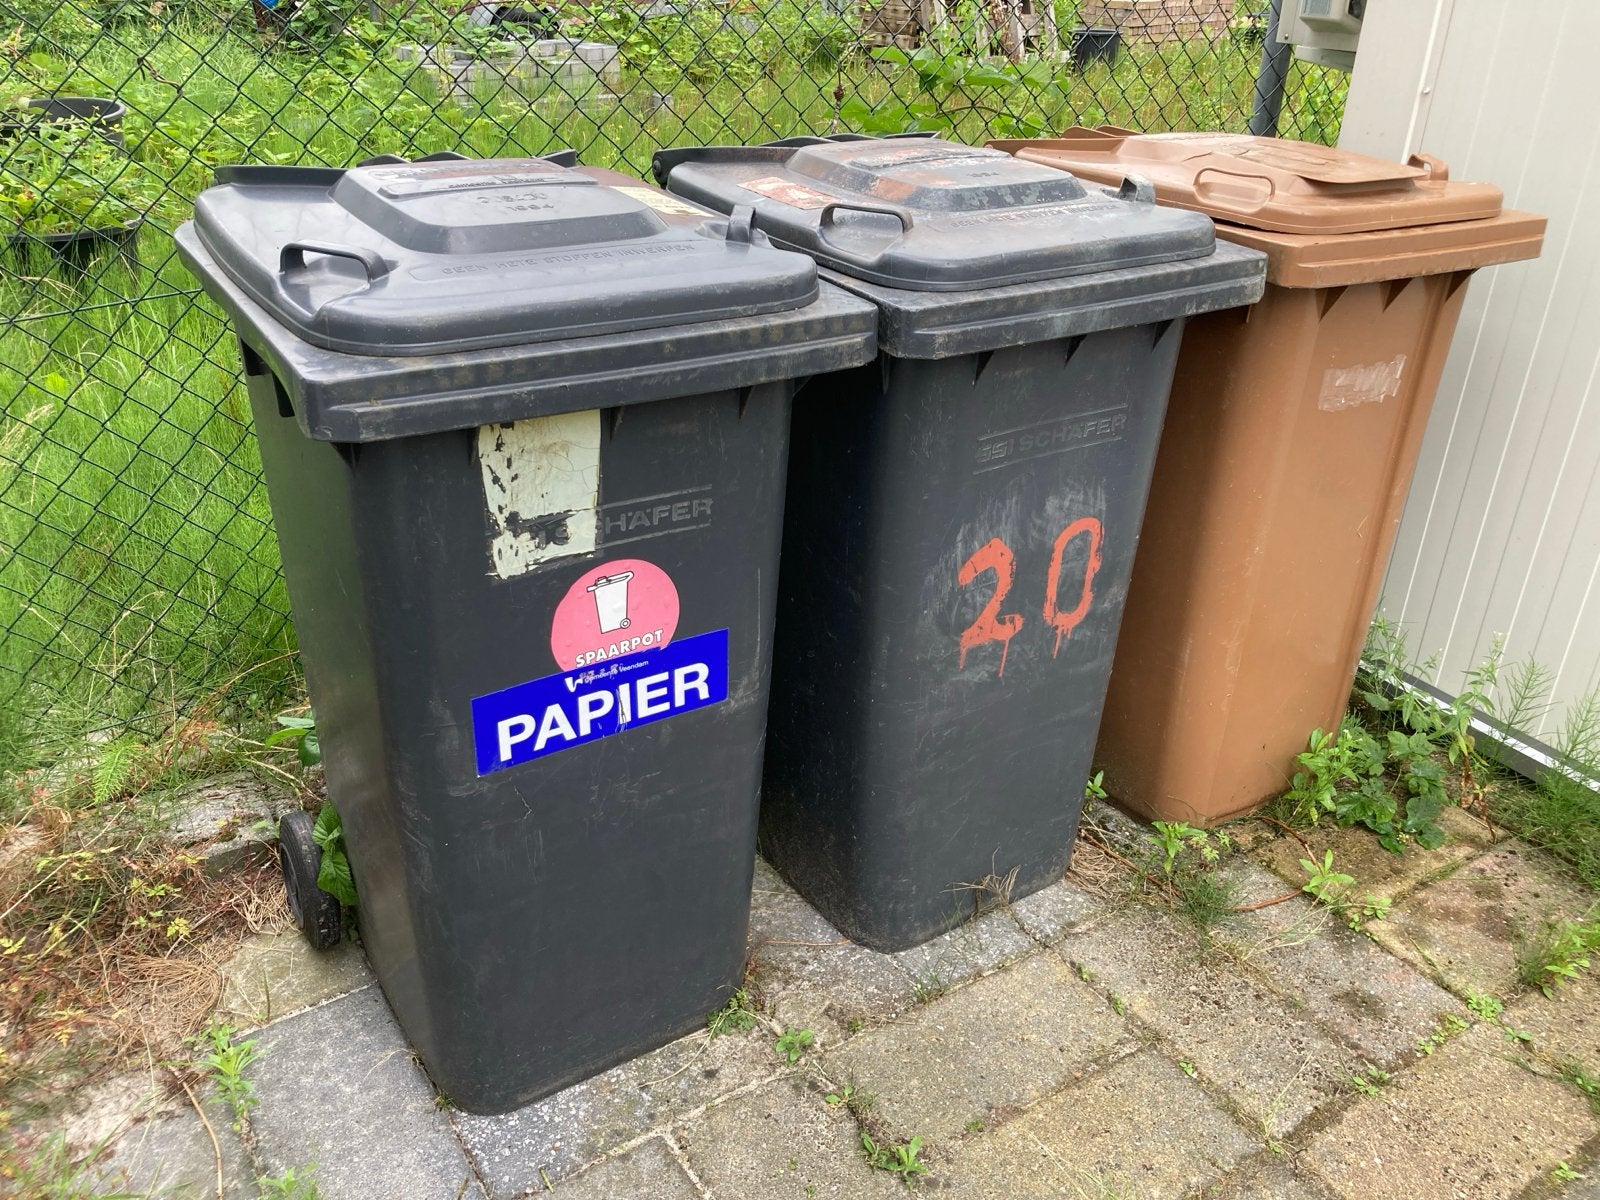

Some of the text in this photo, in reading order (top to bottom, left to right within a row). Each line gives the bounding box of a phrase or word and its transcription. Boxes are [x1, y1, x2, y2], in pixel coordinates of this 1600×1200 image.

[574, 628, 665, 668] SPAARPOT
[618, 659, 650, 674] Veendam
[496, 661, 711, 763] PAPIER
